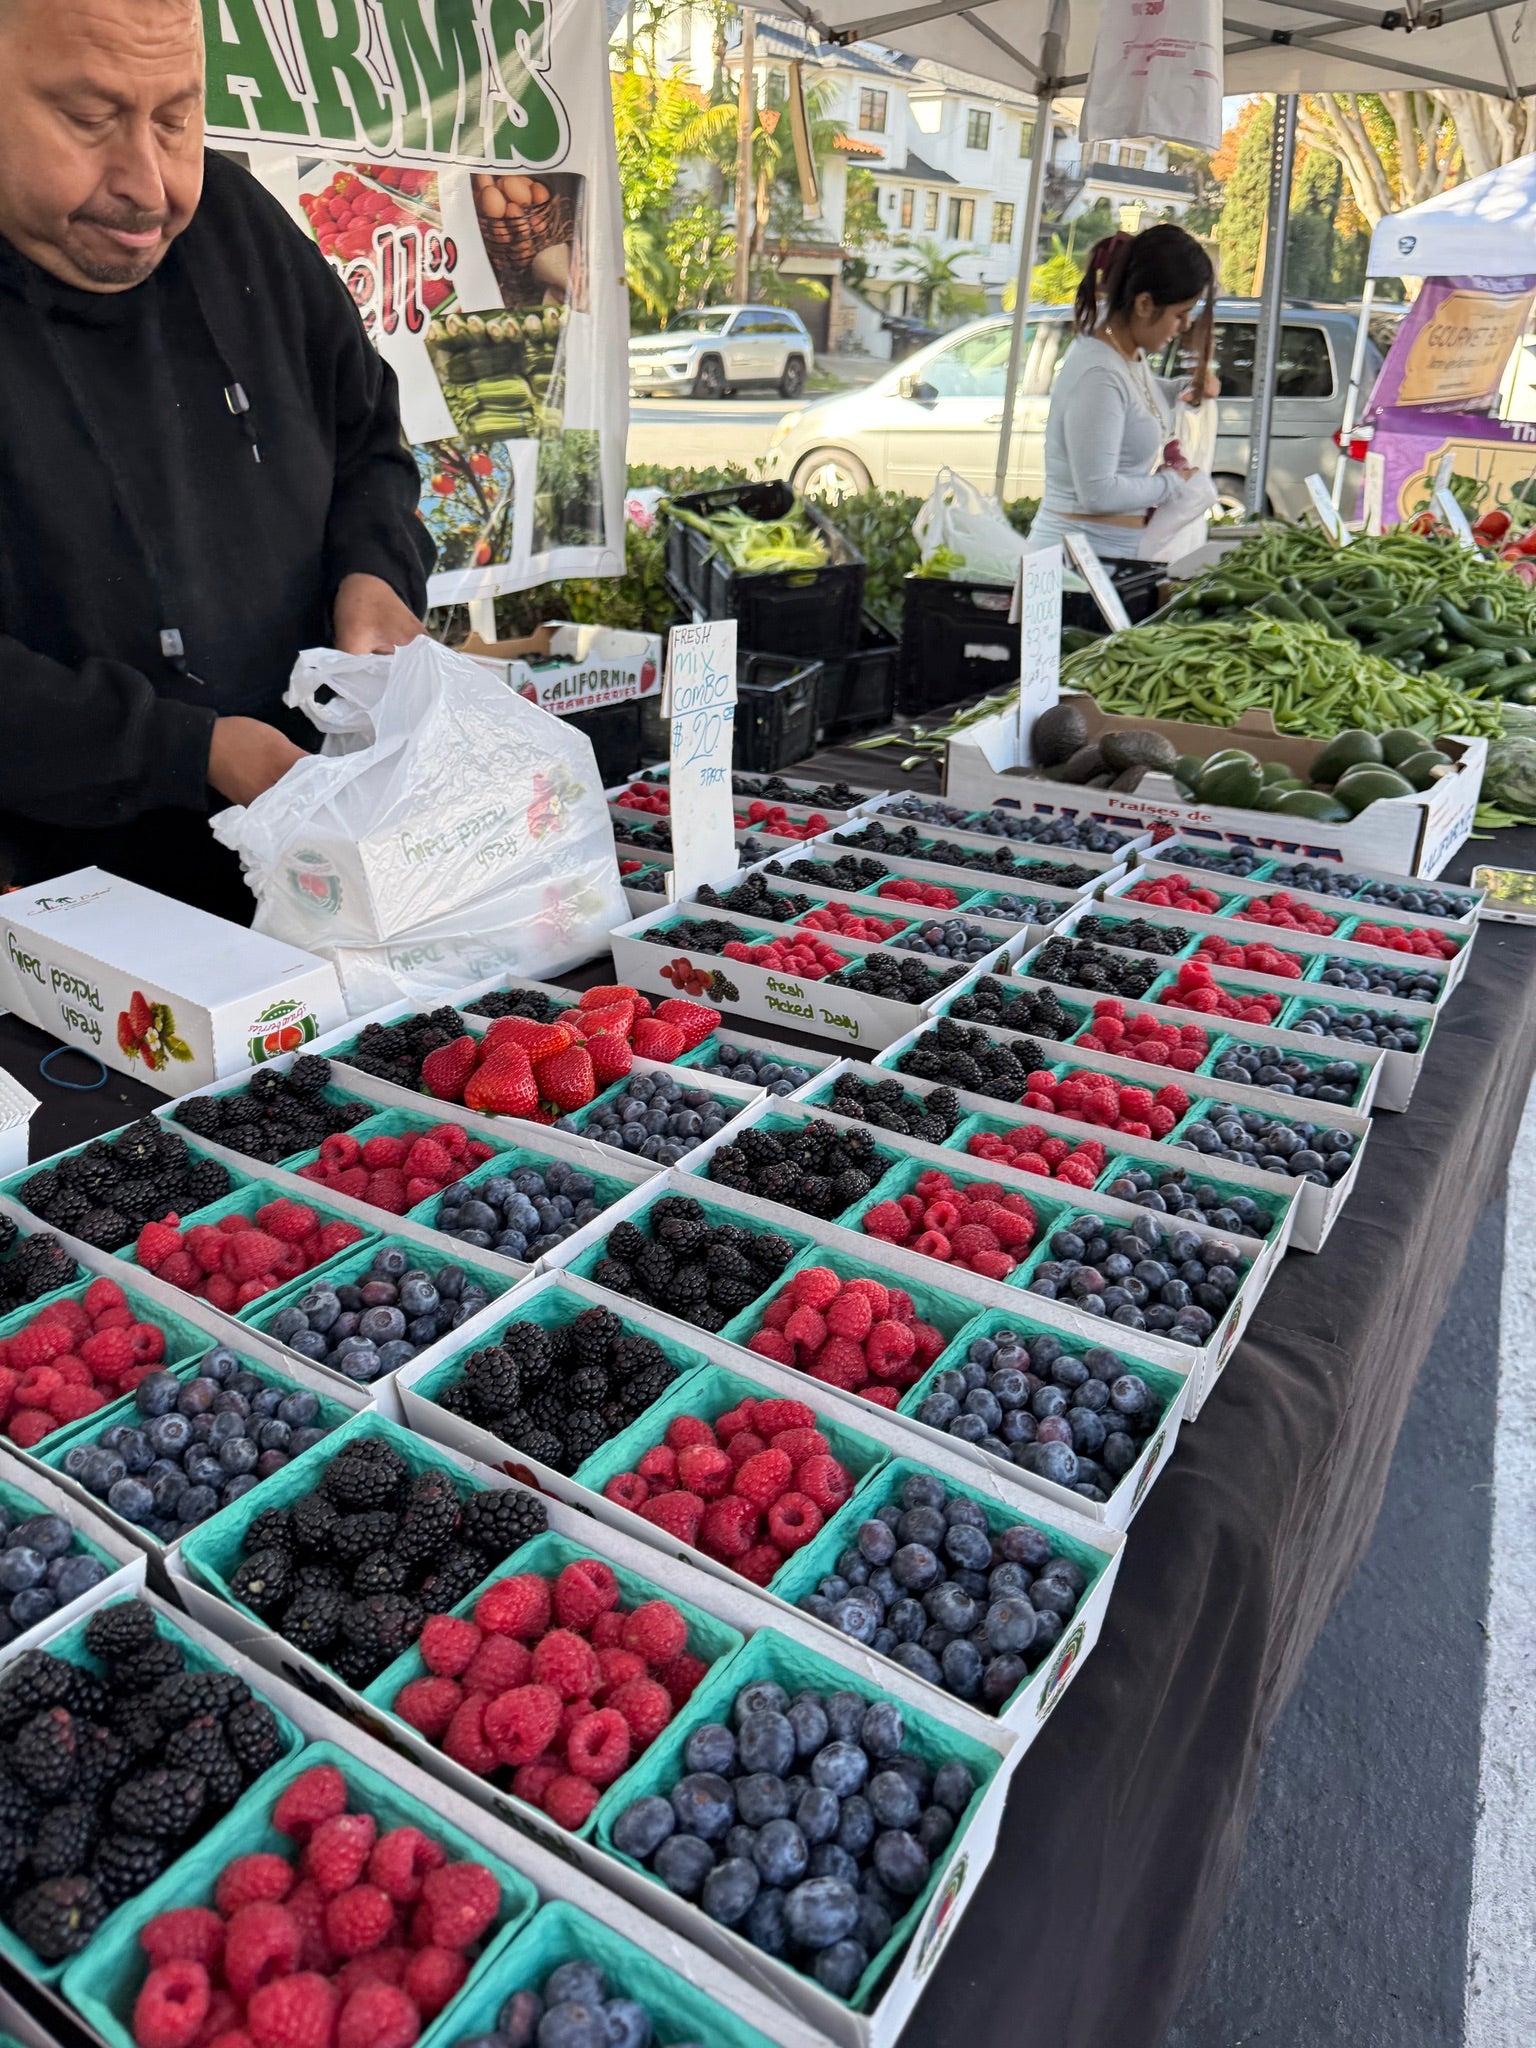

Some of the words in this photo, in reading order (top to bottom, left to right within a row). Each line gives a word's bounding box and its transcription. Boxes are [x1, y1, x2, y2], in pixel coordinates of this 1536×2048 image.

[673, 625, 712, 647] FRESH
[542, 669, 637, 700] CALIFORNIA
[1107, 798, 1180, 819] Fraises
[1186, 811, 1213, 824] de
[8, 931, 46, 985] Daily
[50, 968, 104, 1013] Picked
[766, 976, 805, 999] fresh
[61, 1004, 102, 1046] fresh
[764, 995, 814, 1019] Picked
[819, 1008, 860, 1039] Daily
